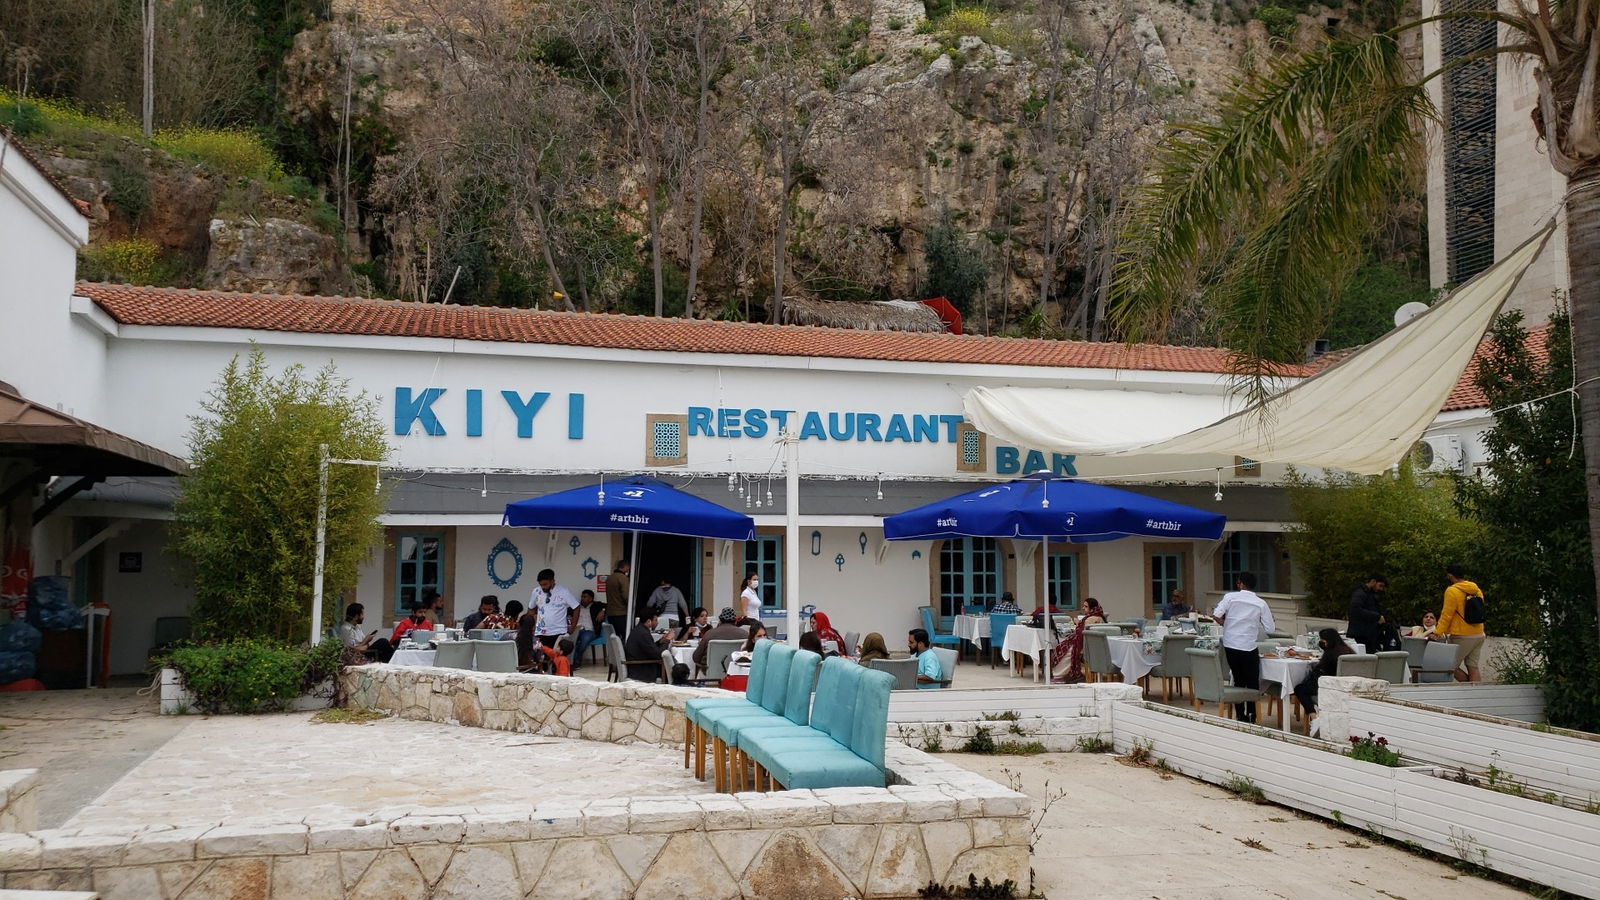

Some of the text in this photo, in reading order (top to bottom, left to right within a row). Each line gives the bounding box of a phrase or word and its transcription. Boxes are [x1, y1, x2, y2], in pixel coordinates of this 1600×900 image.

[394, 387, 585, 440] KIYI
[688, 406, 964, 443] RESTAURANT
[996, 446, 1078, 477] BAR
